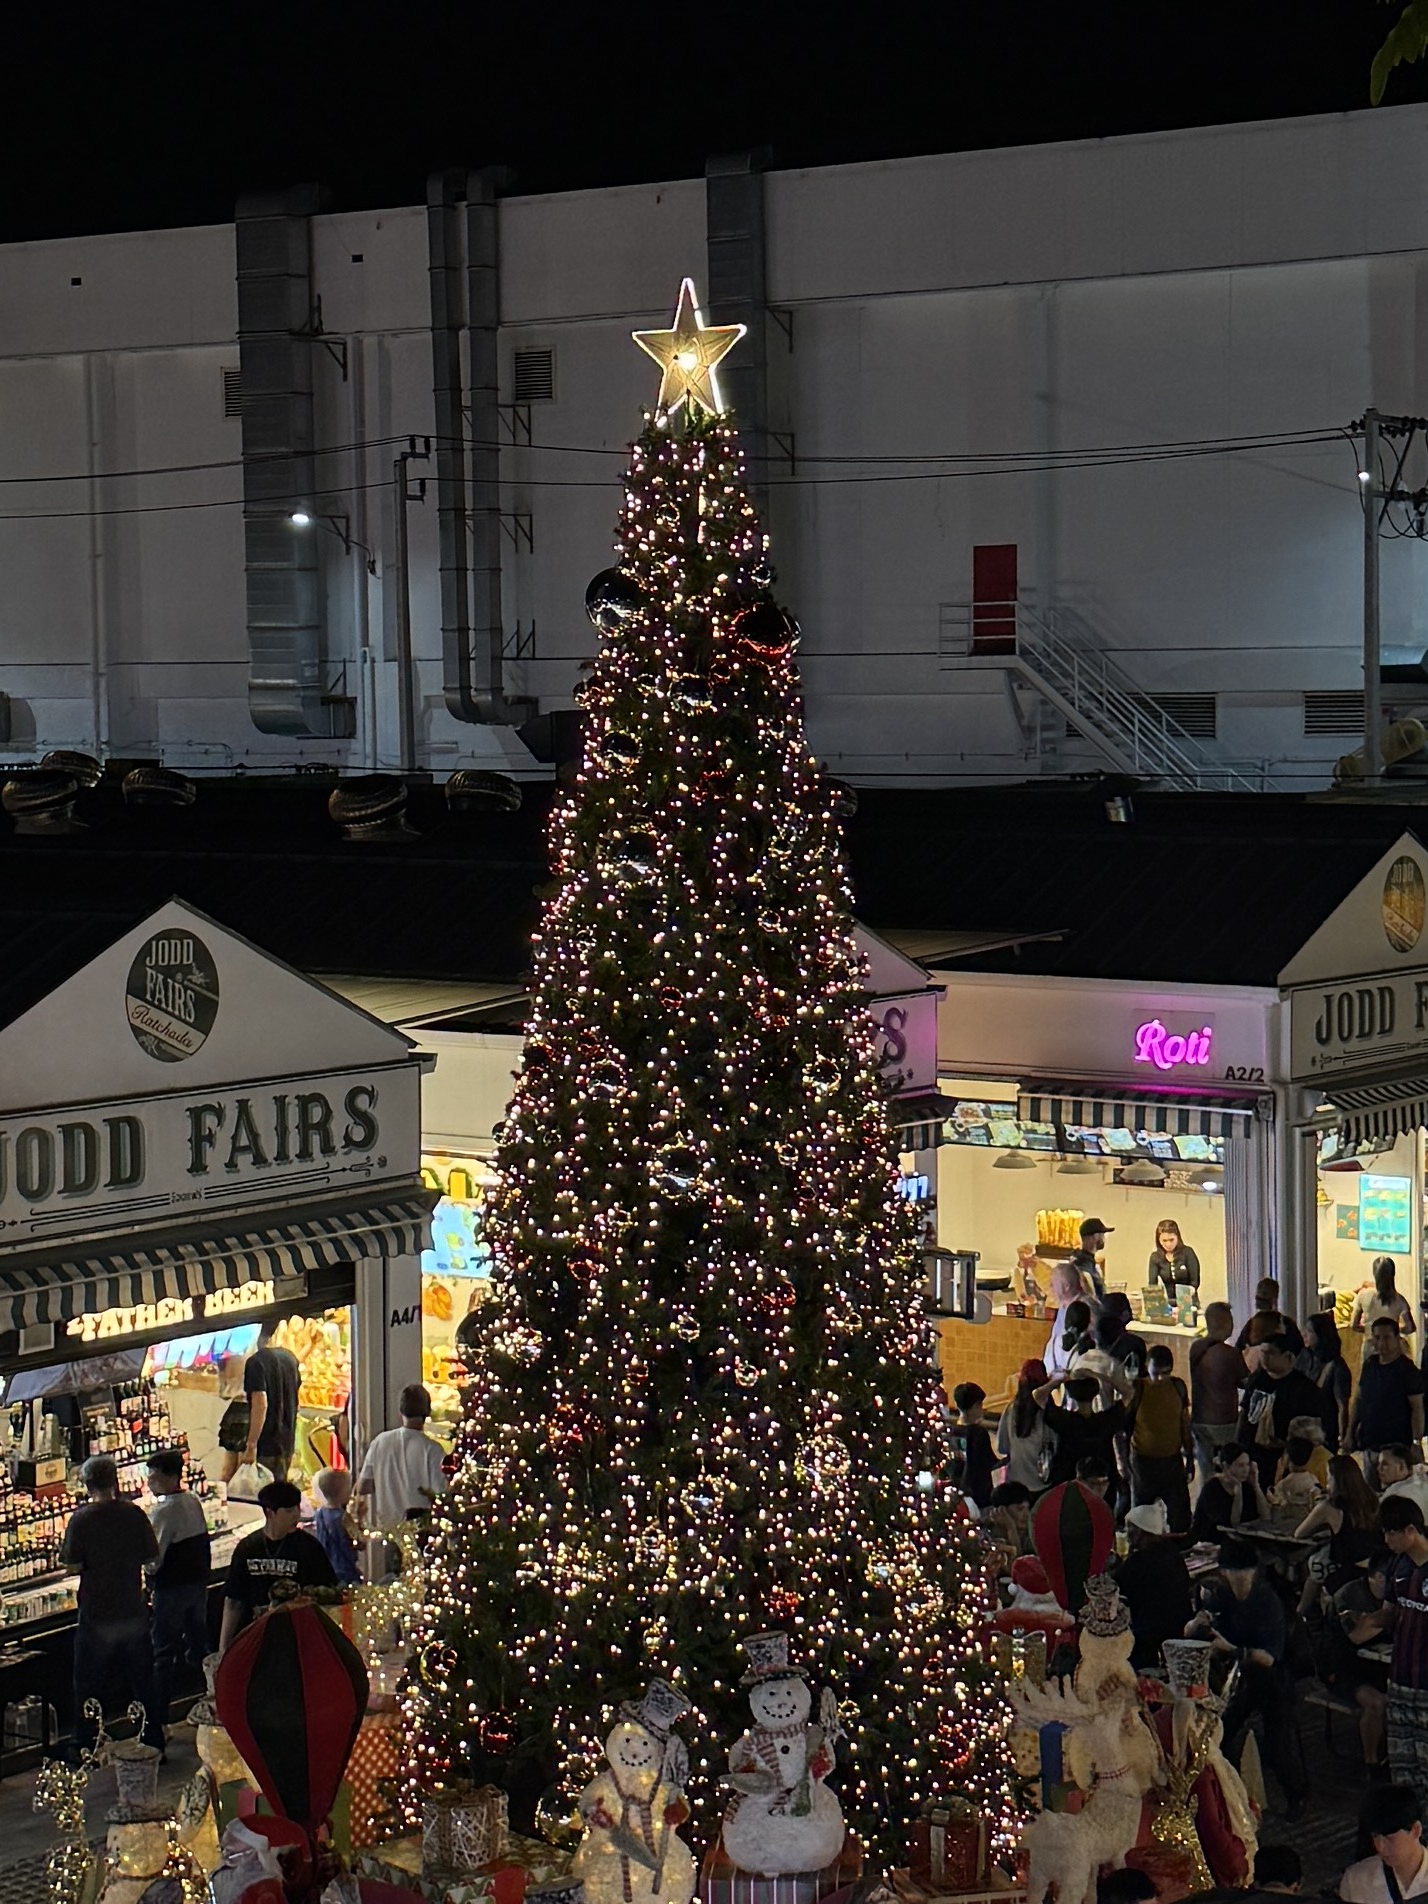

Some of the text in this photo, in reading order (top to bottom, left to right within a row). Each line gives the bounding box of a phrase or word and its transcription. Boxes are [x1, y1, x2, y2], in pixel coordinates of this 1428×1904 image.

[146, 939, 194, 966] JODD
[146, 967, 196, 1024] FAIRS
[1315, 986, 1395, 1046] JODD
[132, 1004, 194, 1049] Ratchada
[1134, 1019, 1212, 1070] Roti
[1225, 1066, 1264, 1083] A2/2
[185, 1084, 380, 1178] FAIRS
